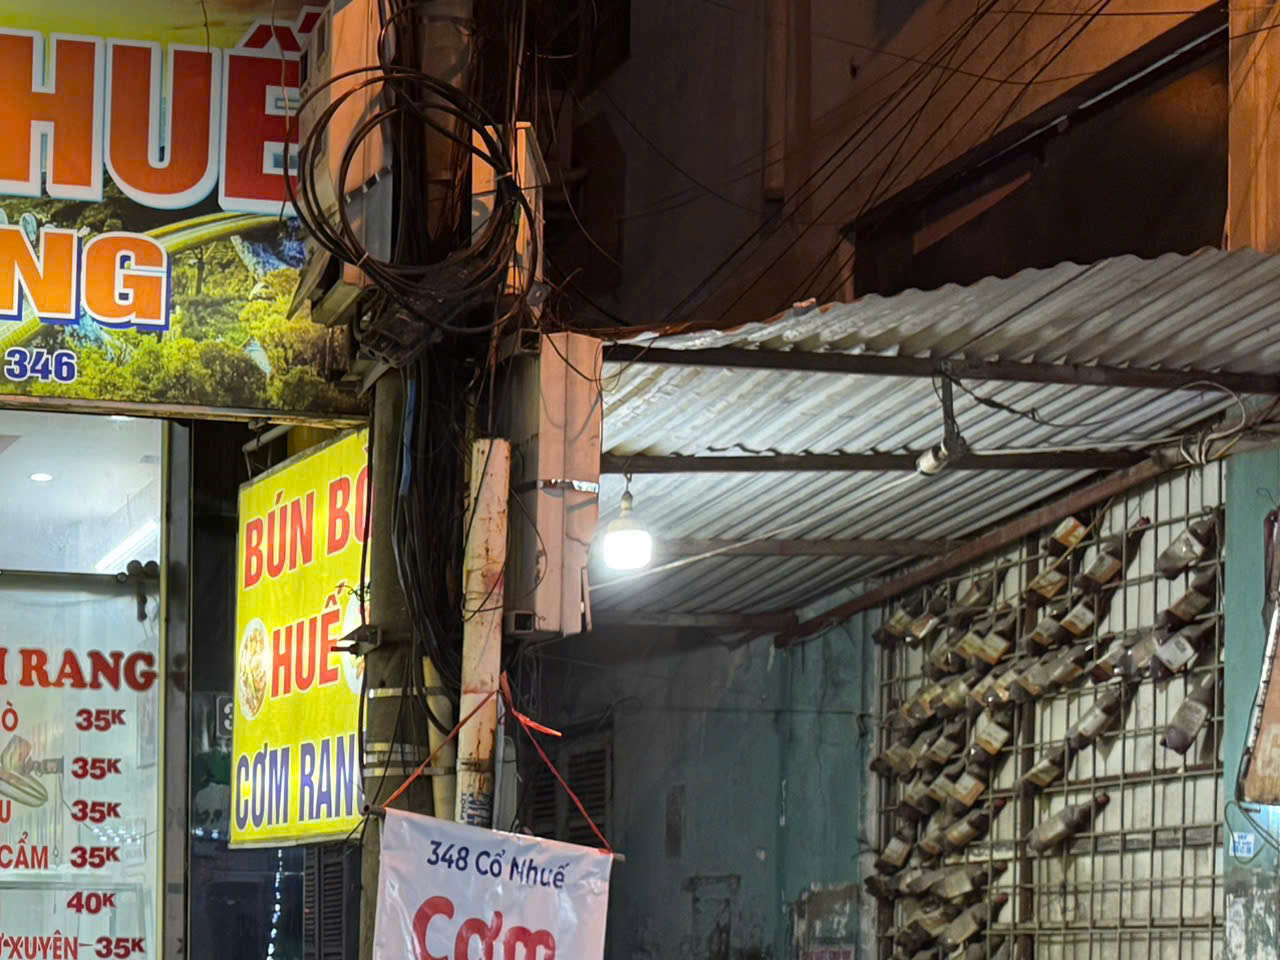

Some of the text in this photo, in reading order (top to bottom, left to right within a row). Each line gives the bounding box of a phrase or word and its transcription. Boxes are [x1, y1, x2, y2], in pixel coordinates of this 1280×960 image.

[4, 347, 76, 383] 346
[243, 491, 316, 589] BÚN
[271, 583, 346, 699] HUẾ
[18, 648, 159, 692] RANG
[75, 708, 126, 732] 35K
[71, 757, 122, 781] 35K
[235, 743, 291, 831] CƠM
[298, 732, 364, 823] RAN
[71, 800, 122, 823] 35K
[70, 846, 121, 869] 35K
[427, 840, 570, 889] 348 Cổ Nhuế
[66, 891, 117, 914] 40K
[94, 936, 145, 960] 35K
